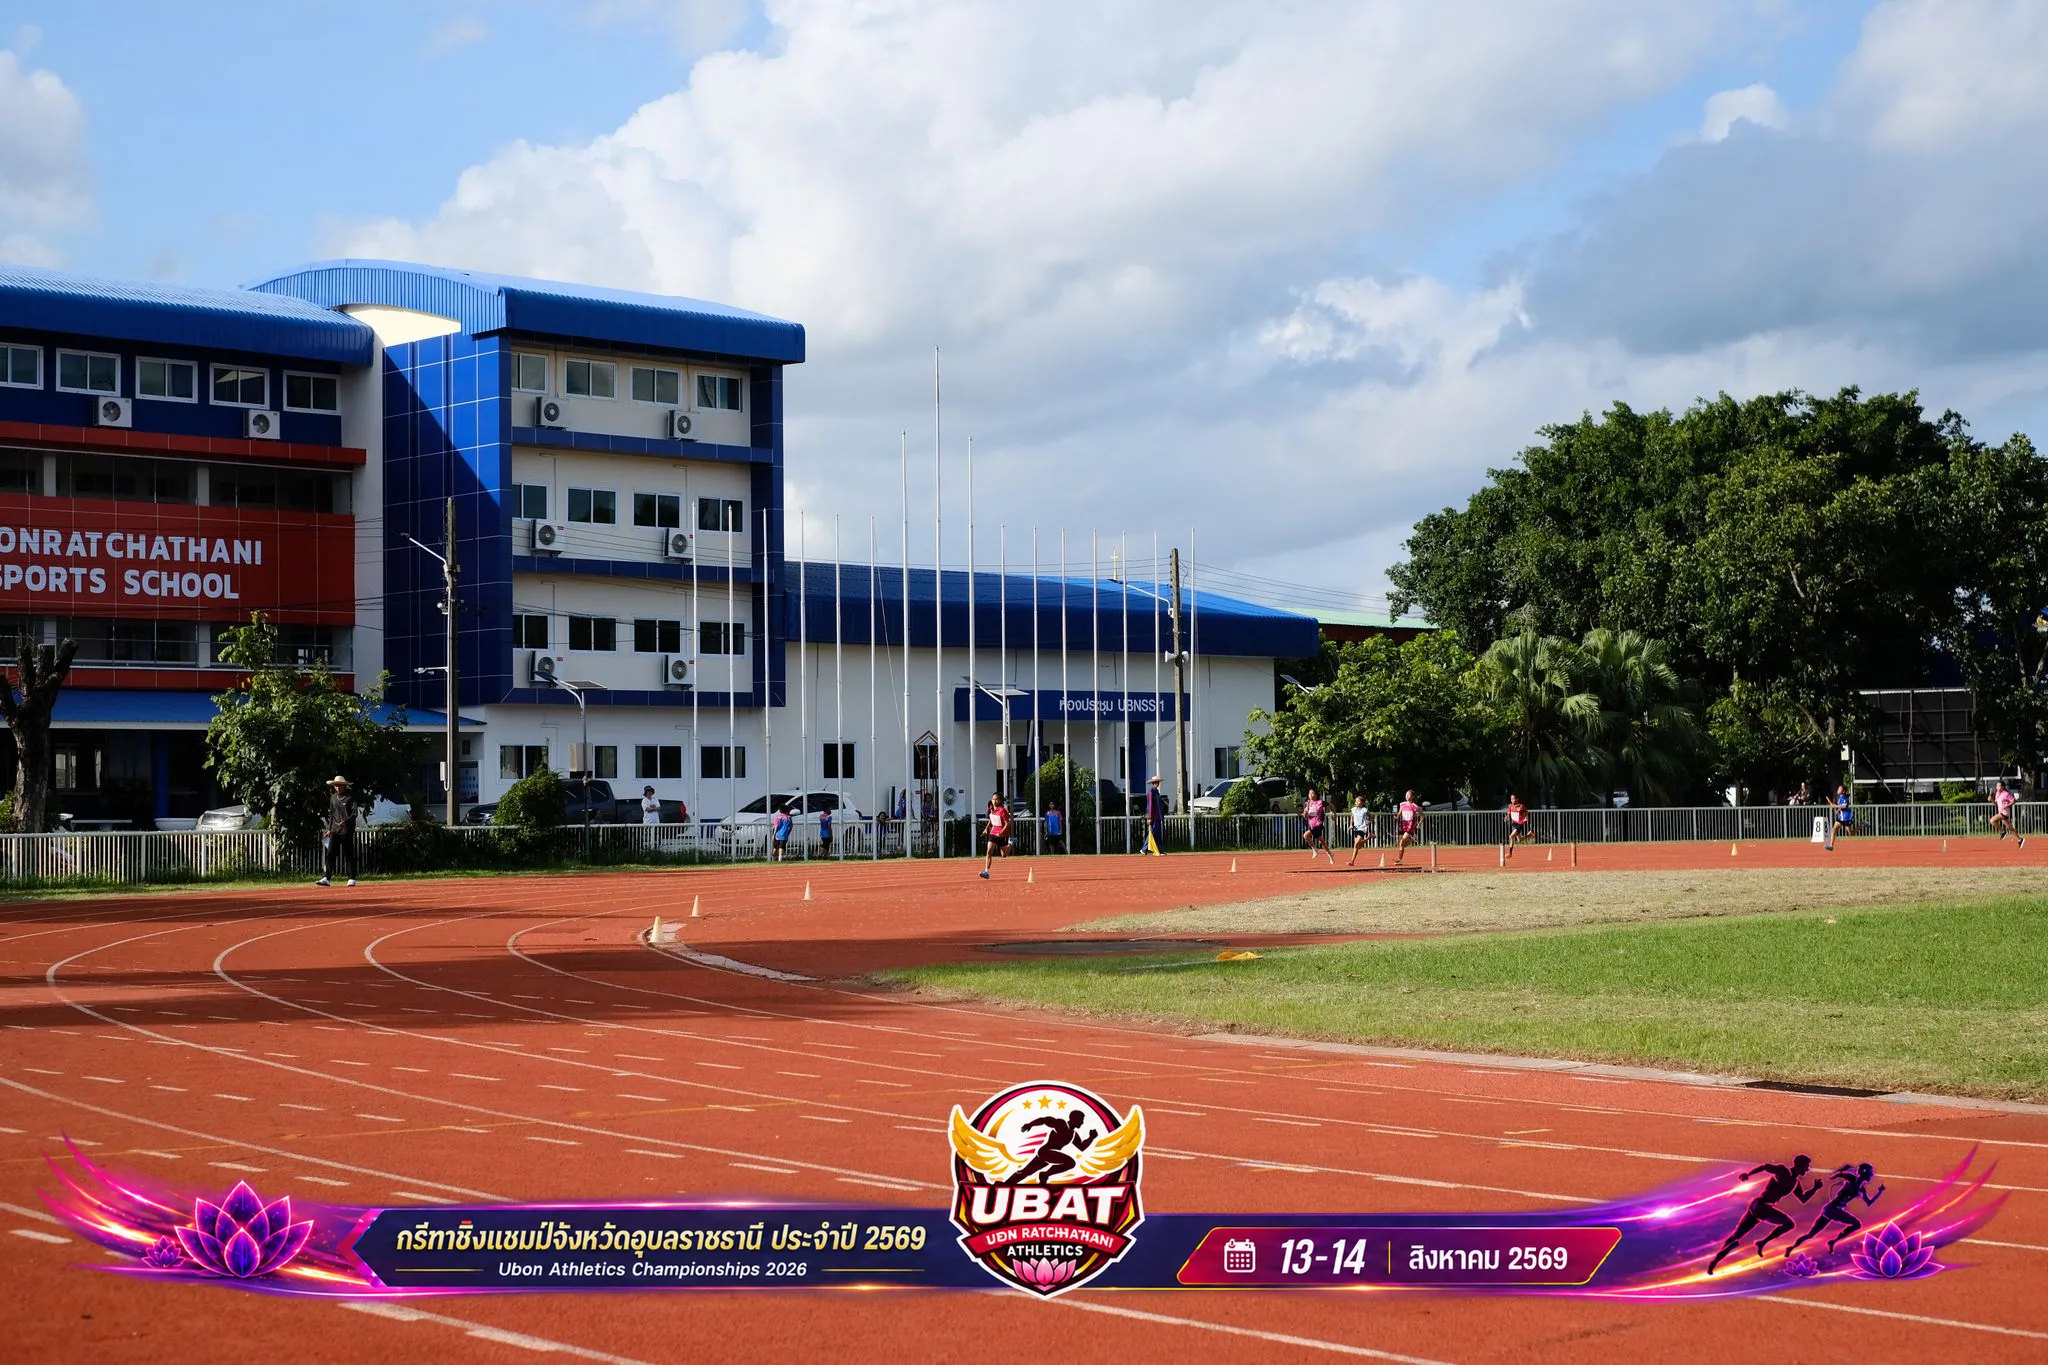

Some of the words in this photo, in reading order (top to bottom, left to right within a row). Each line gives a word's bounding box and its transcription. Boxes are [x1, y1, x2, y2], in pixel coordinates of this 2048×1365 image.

[0, 564, 107, 594] PORTS
[123, 569, 239, 599] SCHOOL
[1815, 820, 1821, 833] 8
